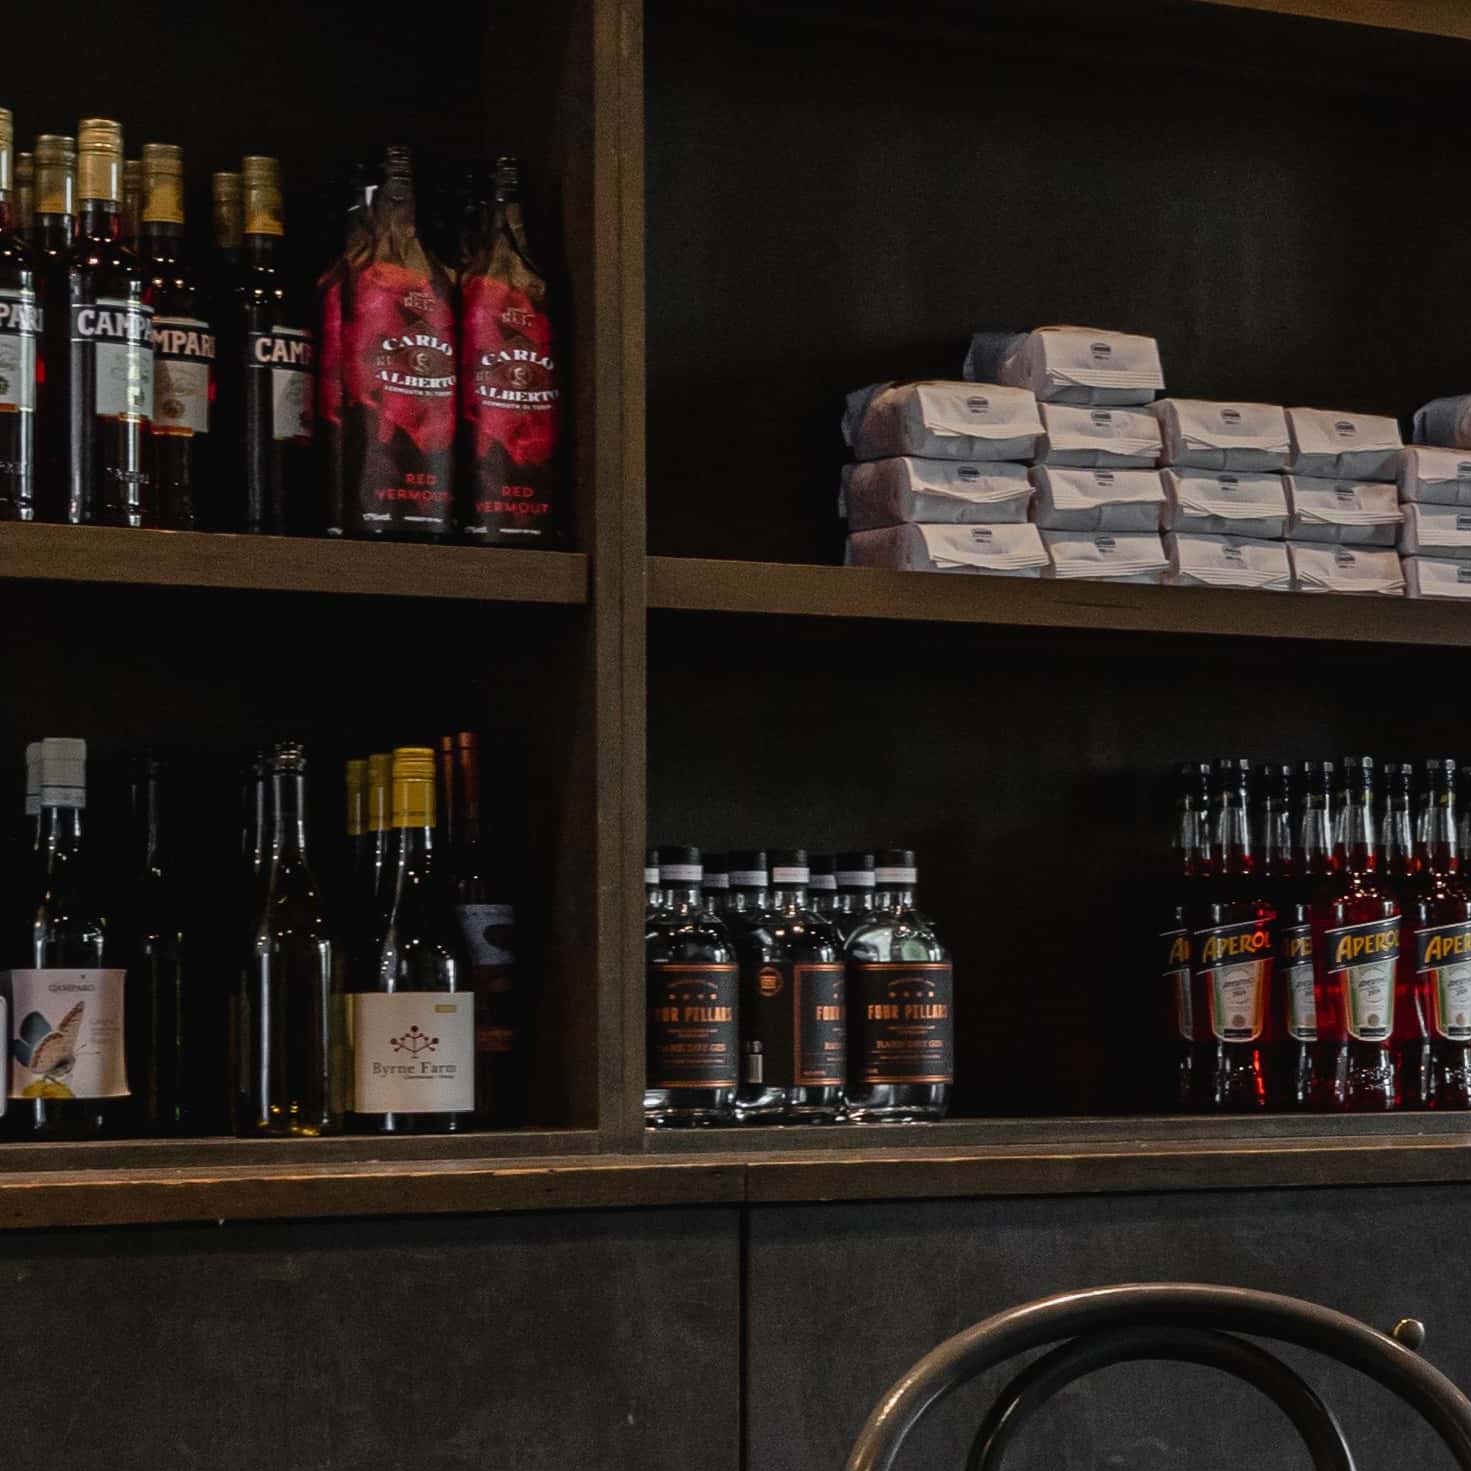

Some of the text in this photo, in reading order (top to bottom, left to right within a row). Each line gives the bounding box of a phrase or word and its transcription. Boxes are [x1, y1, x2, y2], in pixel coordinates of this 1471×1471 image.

[383, 334, 453, 357] CARLO
[481, 349, 554, 370] CARLO
[405, 473, 437, 485] RED
[502, 486, 534, 499] RED
[1201, 930, 1272, 964] APEROL
[372, 1062, 415, 1077] Byrne
